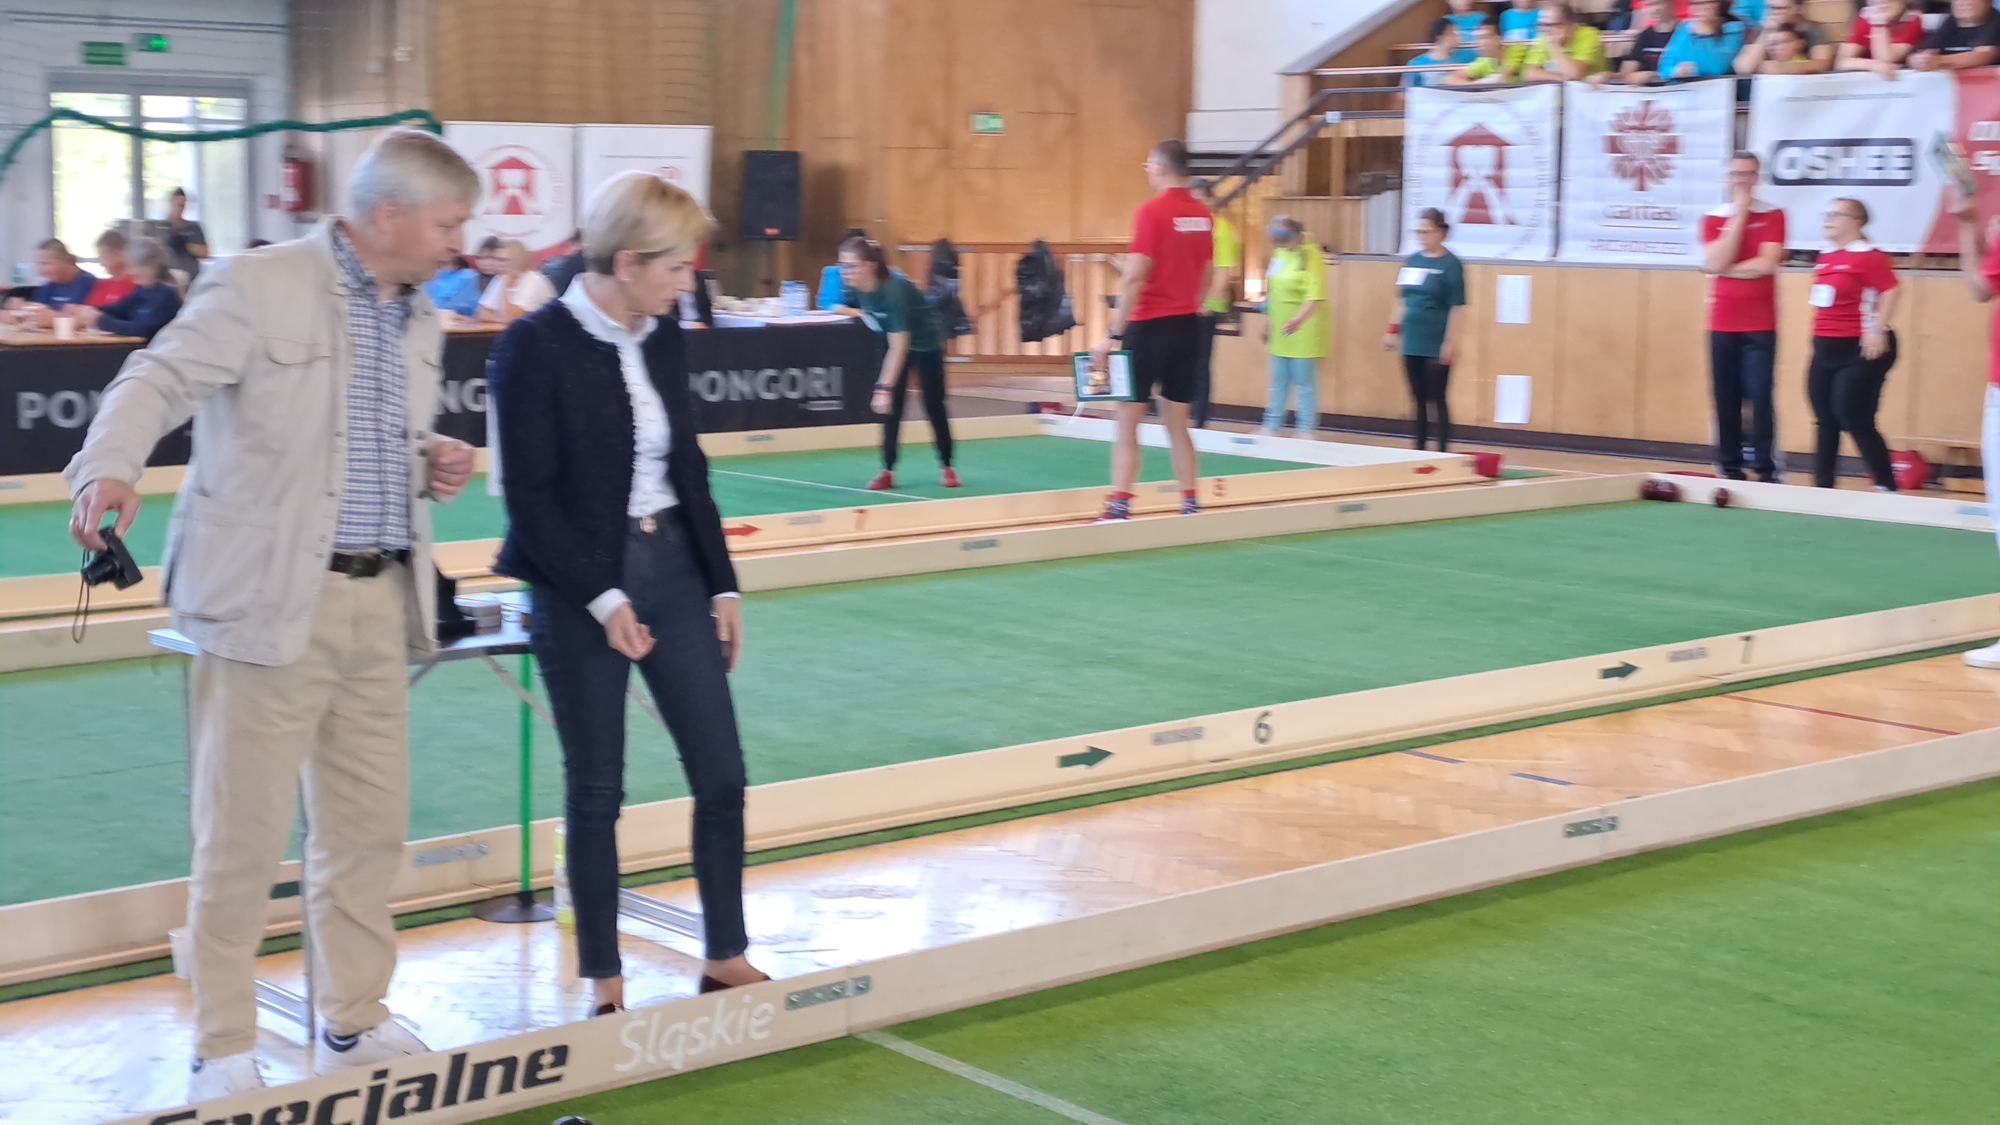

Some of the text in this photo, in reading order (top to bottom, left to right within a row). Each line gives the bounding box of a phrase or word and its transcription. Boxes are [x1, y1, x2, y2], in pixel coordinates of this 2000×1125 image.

[1774, 145, 1913, 180] OSHEE
[16, 390, 101, 429] PO
[1739, 635, 1757, 665] 7
[1253, 710, 1273, 745] 6
[614, 995, 775, 1072] Śląskie
